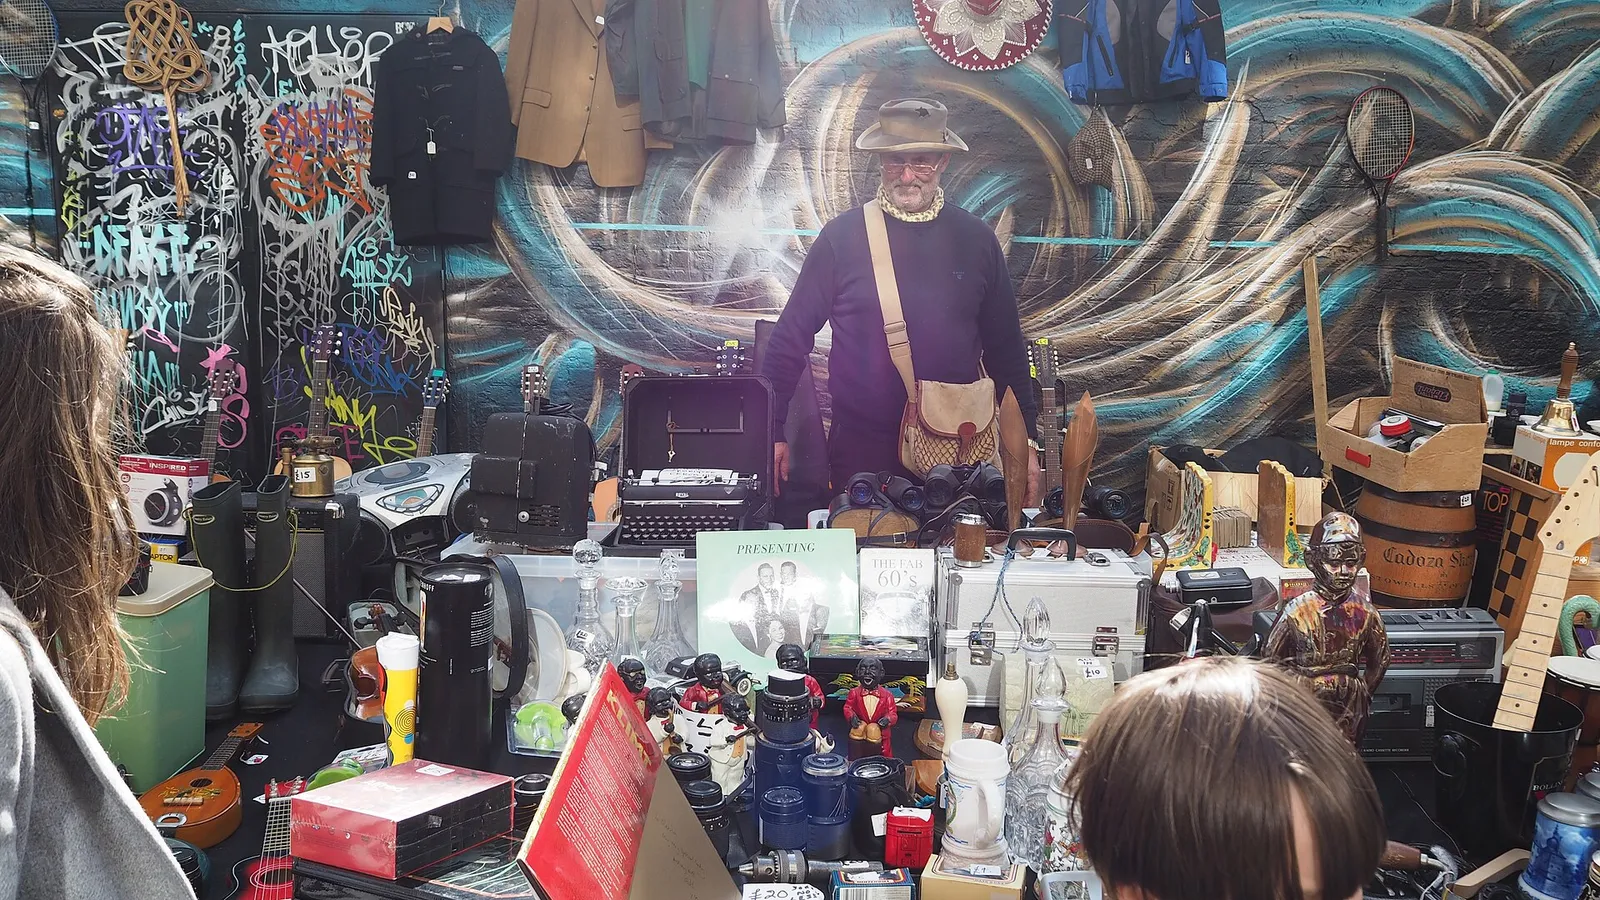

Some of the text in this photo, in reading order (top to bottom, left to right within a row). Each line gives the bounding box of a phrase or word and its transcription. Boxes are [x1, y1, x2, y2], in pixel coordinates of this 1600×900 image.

[149, 462, 186, 471] INSPIRED
[1484, 490, 1509, 513] TOP
[736, 542, 815, 555] PRESENTING
[151, 553, 173, 561] APTOR
[872, 558, 923, 568] THE FAB
